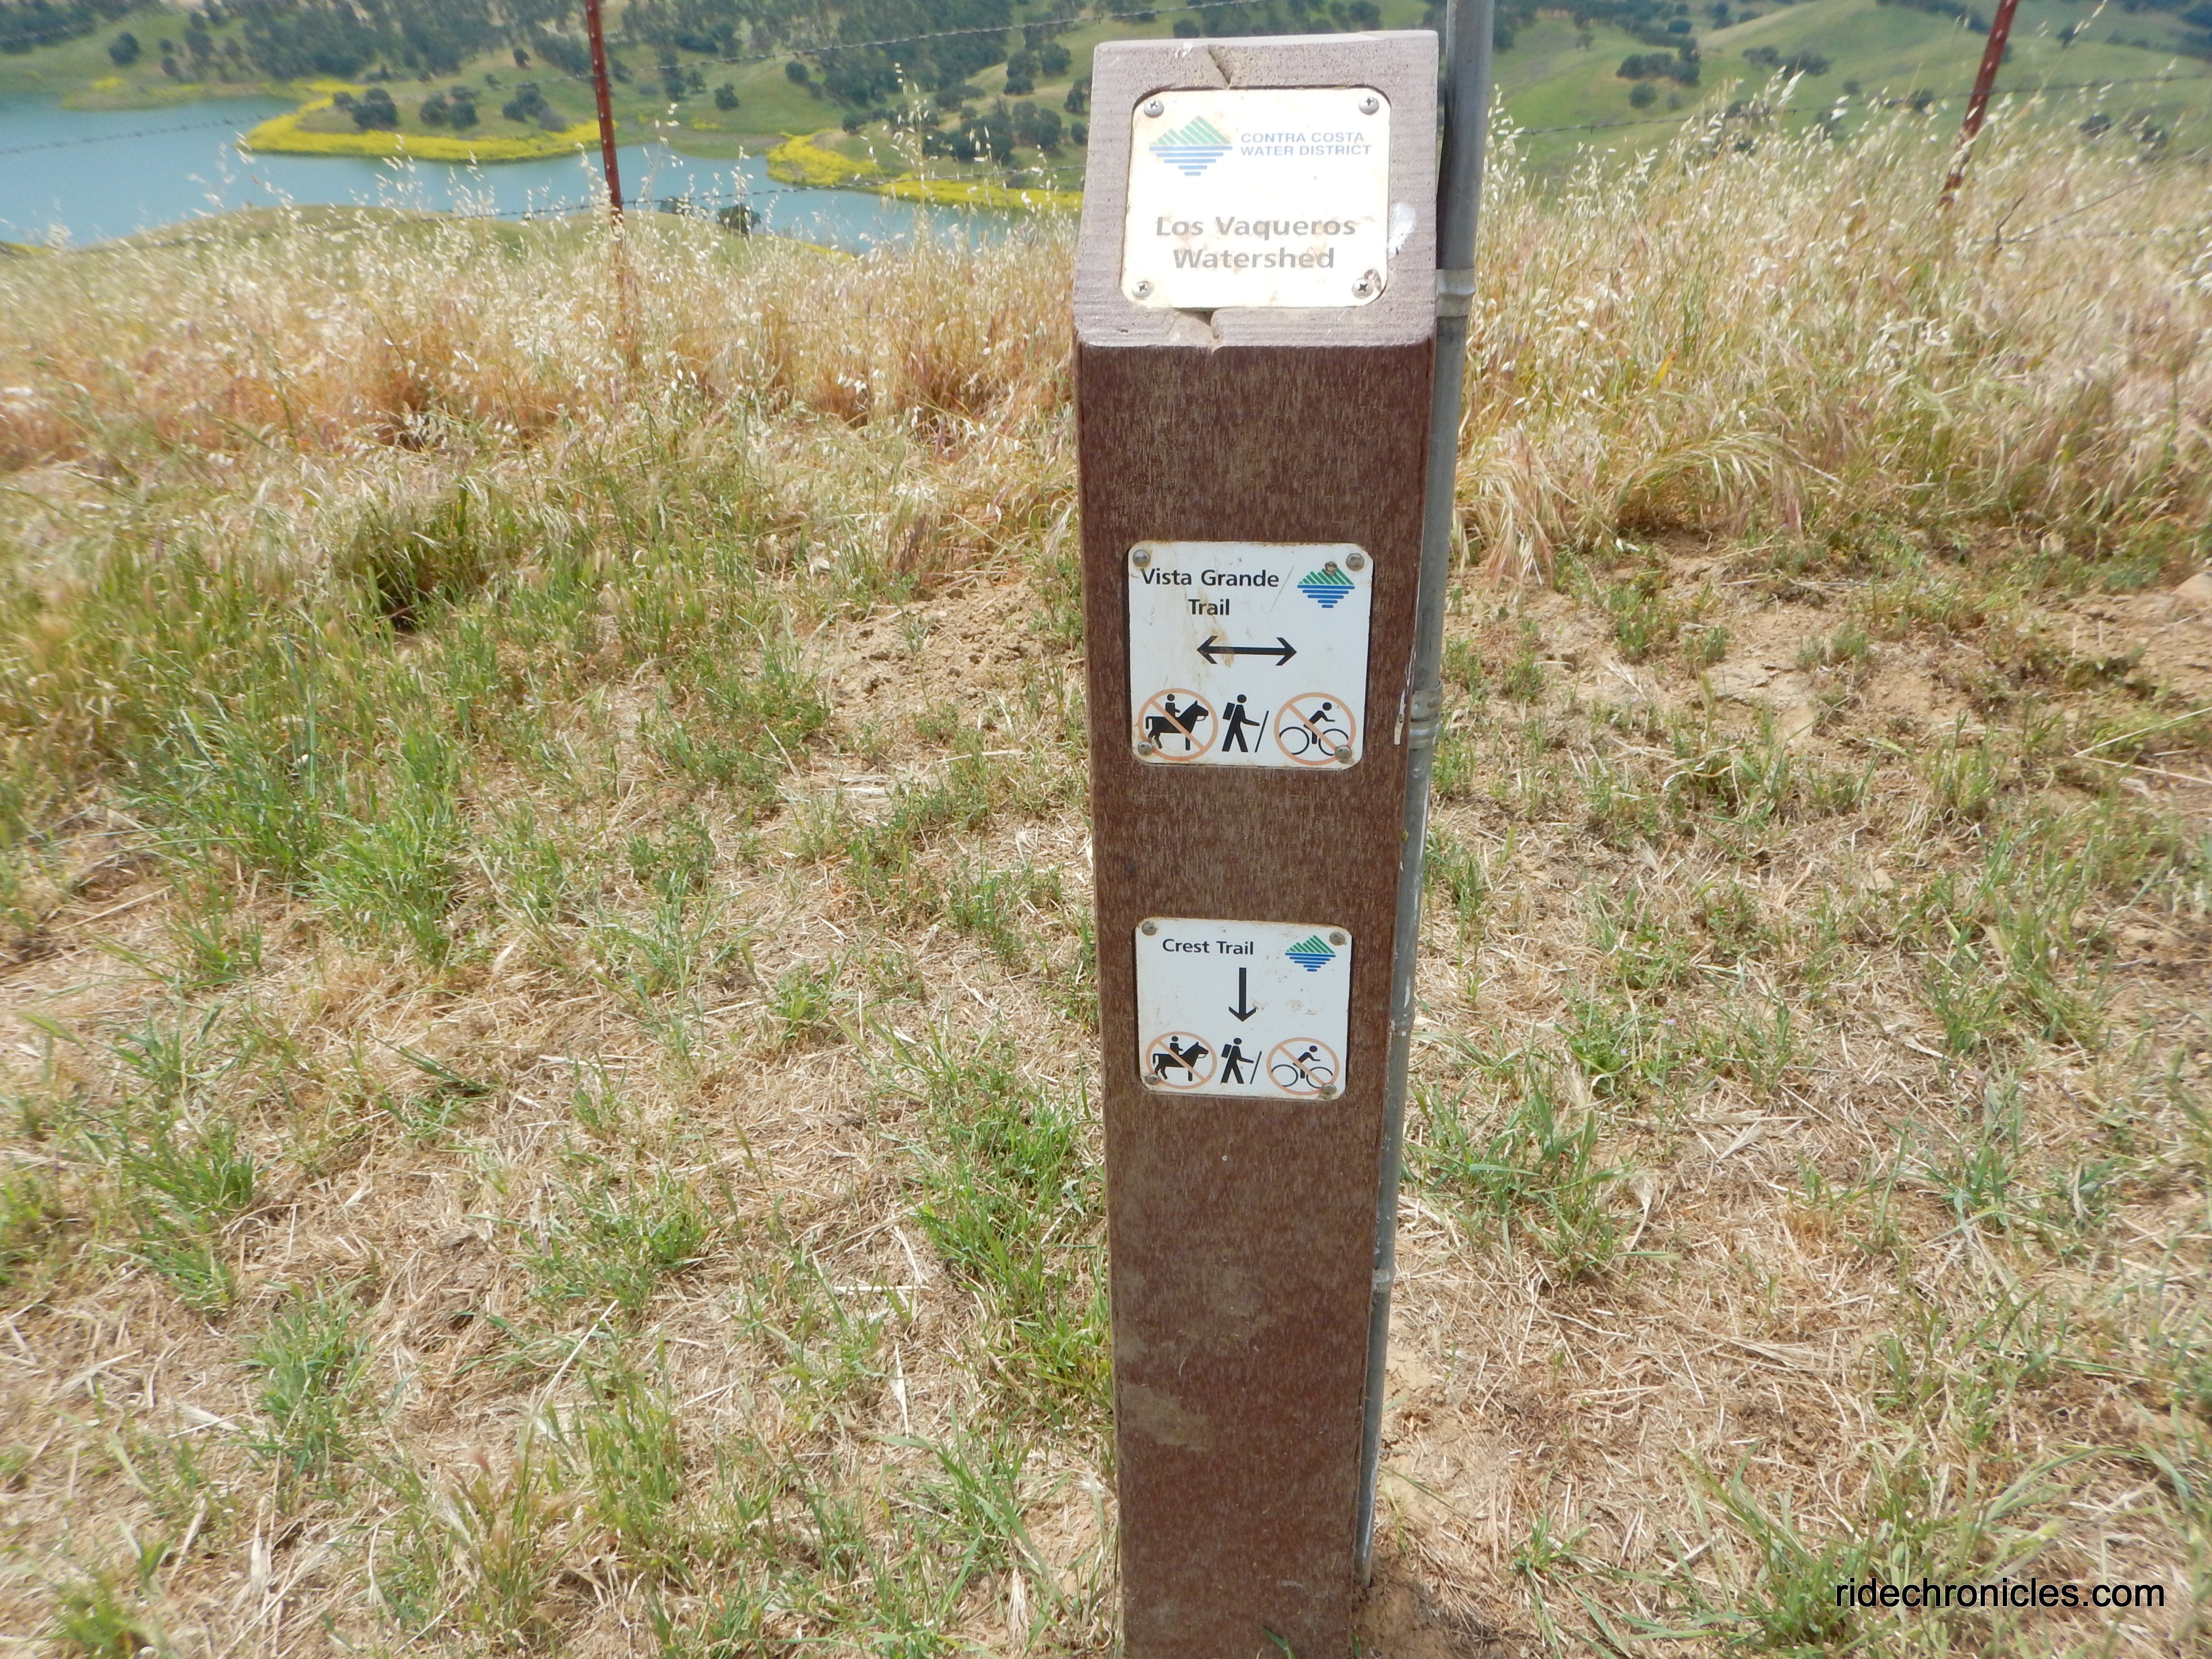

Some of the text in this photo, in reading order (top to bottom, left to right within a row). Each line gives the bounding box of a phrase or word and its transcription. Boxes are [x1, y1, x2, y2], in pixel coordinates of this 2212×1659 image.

[1241, 132, 1364, 144] CONTRA COSTA
[1241, 144, 1372, 156] WATER DISTRICT
[1156, 216, 1356, 240] Los Vaqueros
[1173, 248, 1334, 269] Watershed
[1142, 568, 1279, 588] Vista Grande
[1188, 599, 1230, 615] Trail
[1162, 938, 1254, 955] Crest Trail
